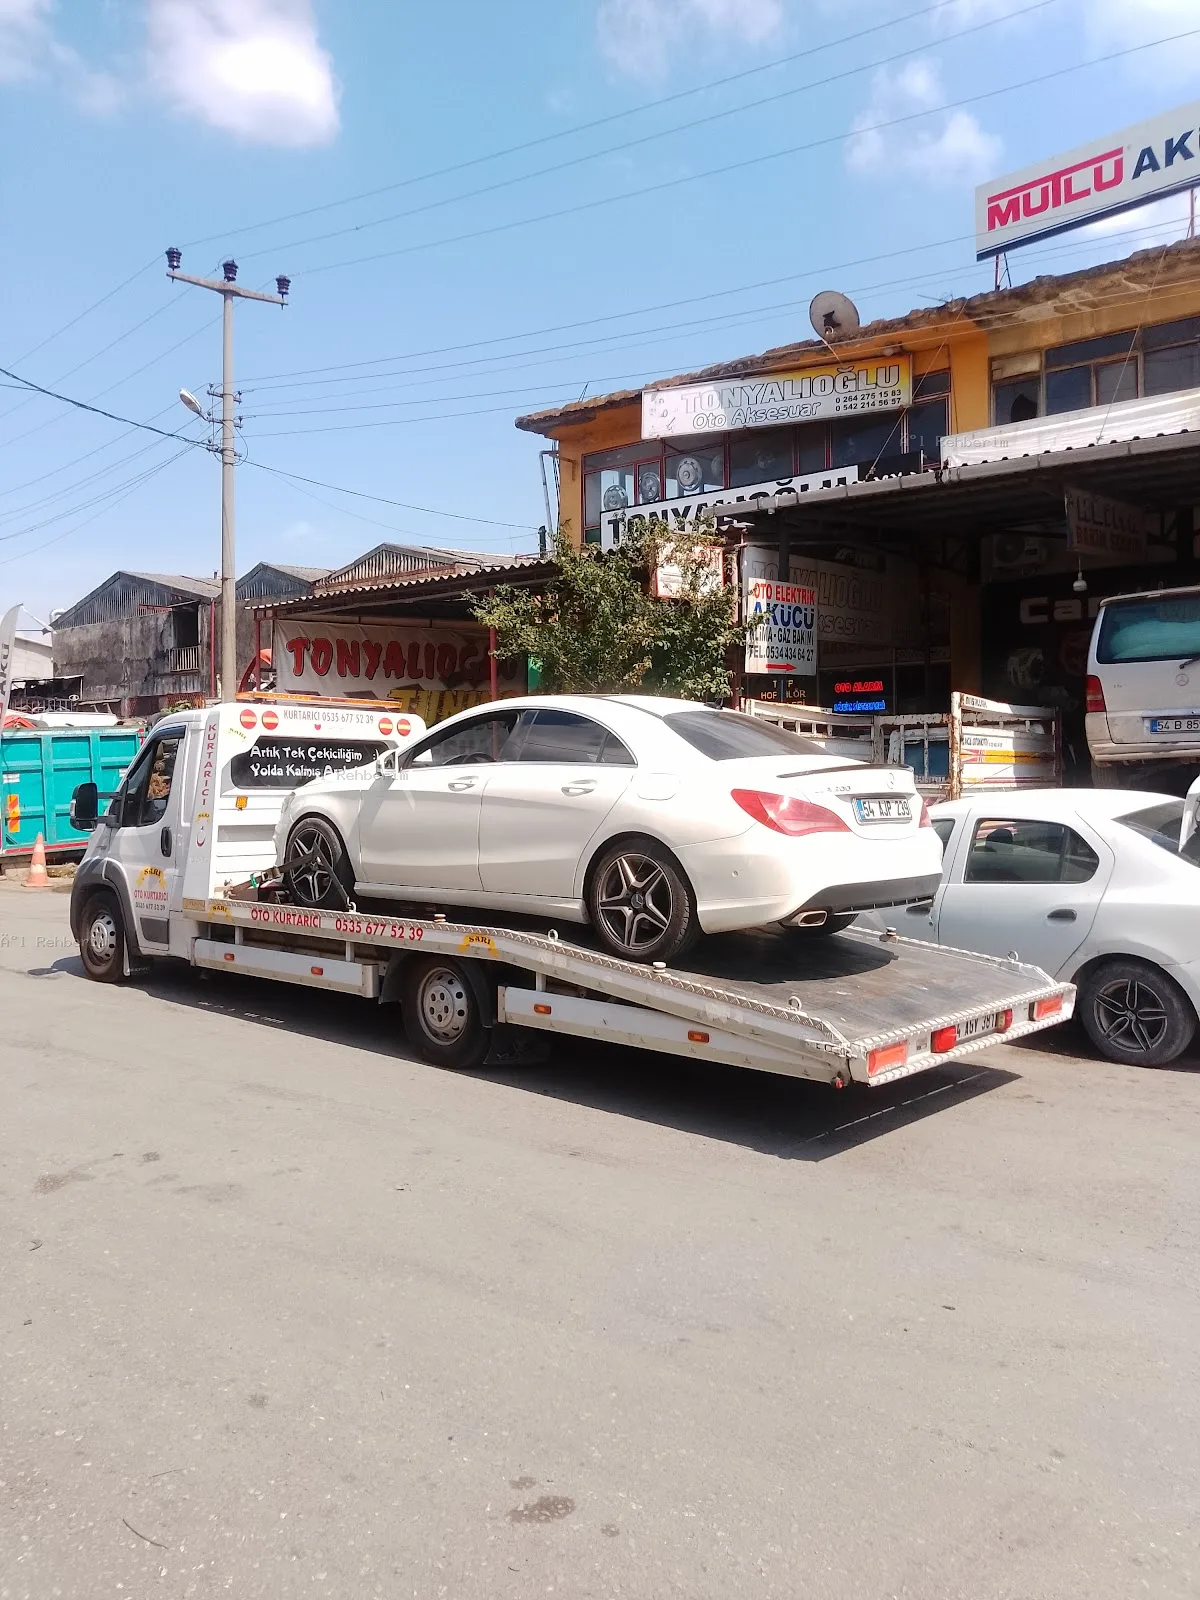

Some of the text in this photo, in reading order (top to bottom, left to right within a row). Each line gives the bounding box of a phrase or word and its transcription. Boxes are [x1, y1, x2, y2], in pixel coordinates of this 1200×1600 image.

[987, 126, 1200, 231] MUTLU AK
[682, 365, 899, 413] TONYALIOĞLU
[843, 395, 858, 403] 264
[878, 391, 888, 399] 15
[891, 389, 901, 397] 83
[843, 403, 858, 411] 542
[860, 401, 876, 409] 214
[891, 397, 901, 405] 57
[693, 402, 822, 430] Oto Aksesuar
[753, 583, 815, 605] OTO ELEKTRİK
[754, 602, 815, 629] AKÜCÜ
[778, 628, 791, 643] GAZ
[834, 683, 851, 693] OTO
[284, 710, 374, 724] KURTARICI 0535 677 52 39
[1157, 720, 1200, 730] 54 B 85
[250, 745, 280, 760] Artık
[281, 746, 306, 760] Tek
[308, 746, 362, 762] Çekiciliğim
[202, 724, 217, 806] KURTARICI
[250, 762, 283, 777] Yolda
[863, 801, 875, 817] 54
[144, 867, 161, 877] SARI
[134, 890, 144, 899] OTO
[212, 905, 228, 913] SARI
[251, 909, 424, 941] OTO KURTARICI 0535 677 52 39
[468, 935, 491, 945] SARI
